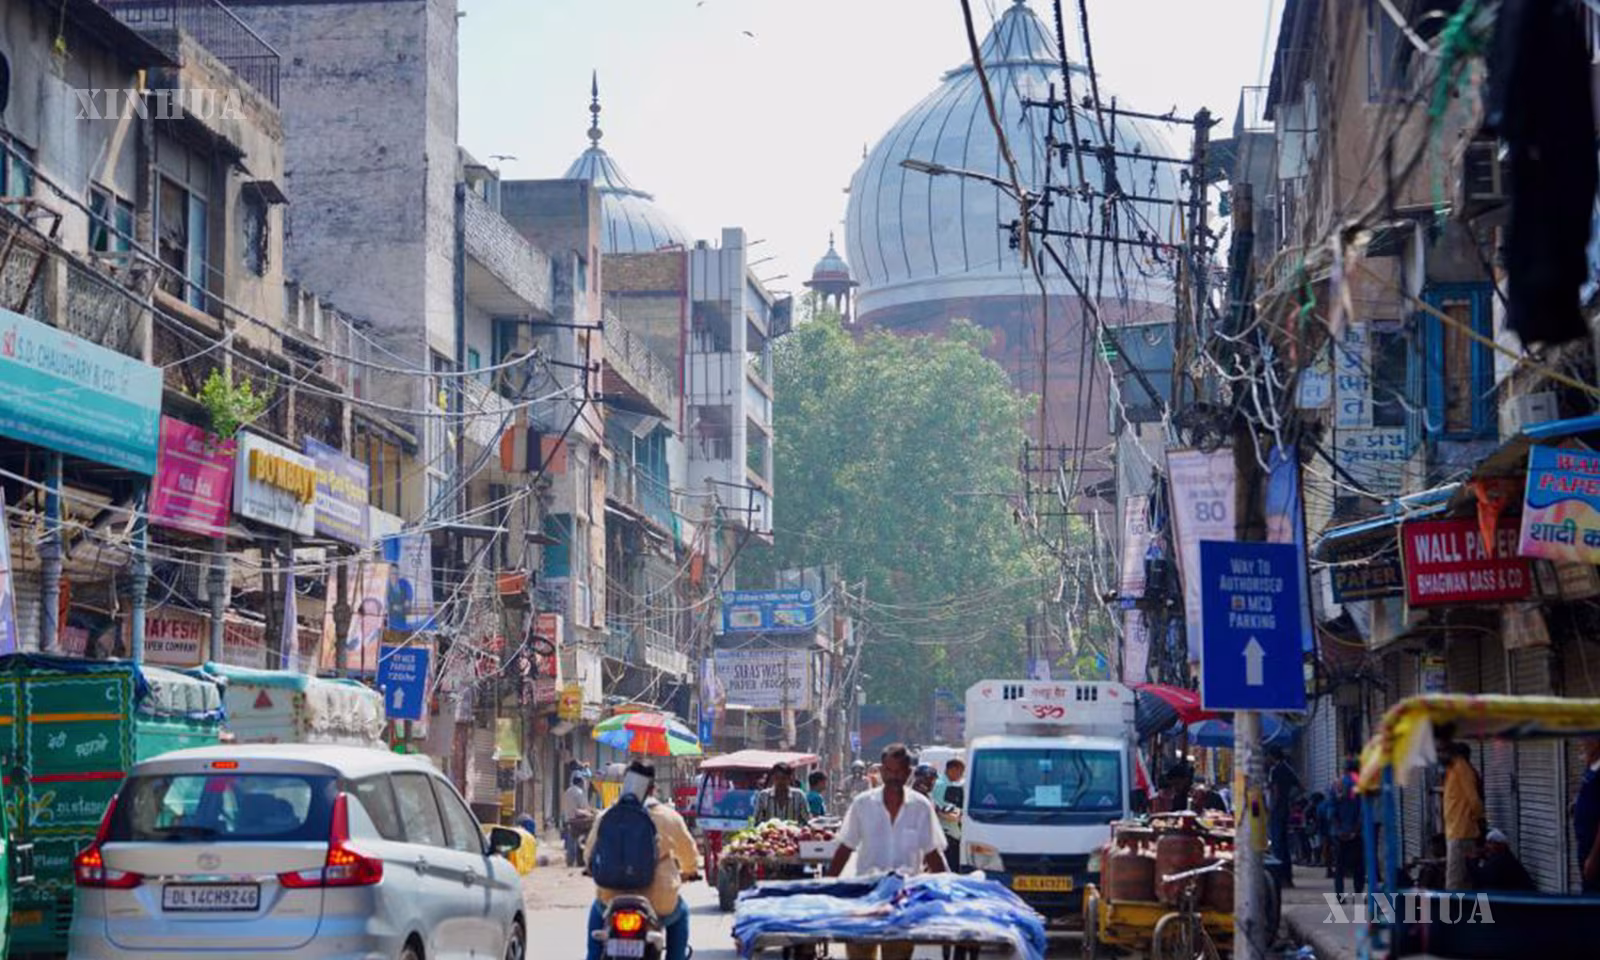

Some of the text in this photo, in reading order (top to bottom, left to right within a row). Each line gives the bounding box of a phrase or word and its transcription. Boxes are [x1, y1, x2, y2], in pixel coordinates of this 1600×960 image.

[248, 450, 316, 505] BOMBAY
[1195, 500, 1226, 521] 80
[1530, 518, 1576, 546] शादी
[1414, 532, 1461, 564] WALL
[1465, 529, 1517, 560] PAER
[1417, 570, 1467, 595] BHAGWAN
[1470, 568, 1496, 591] DASS
[1247, 595, 1273, 612] MCD
[1229, 611, 1276, 629] PARKING
